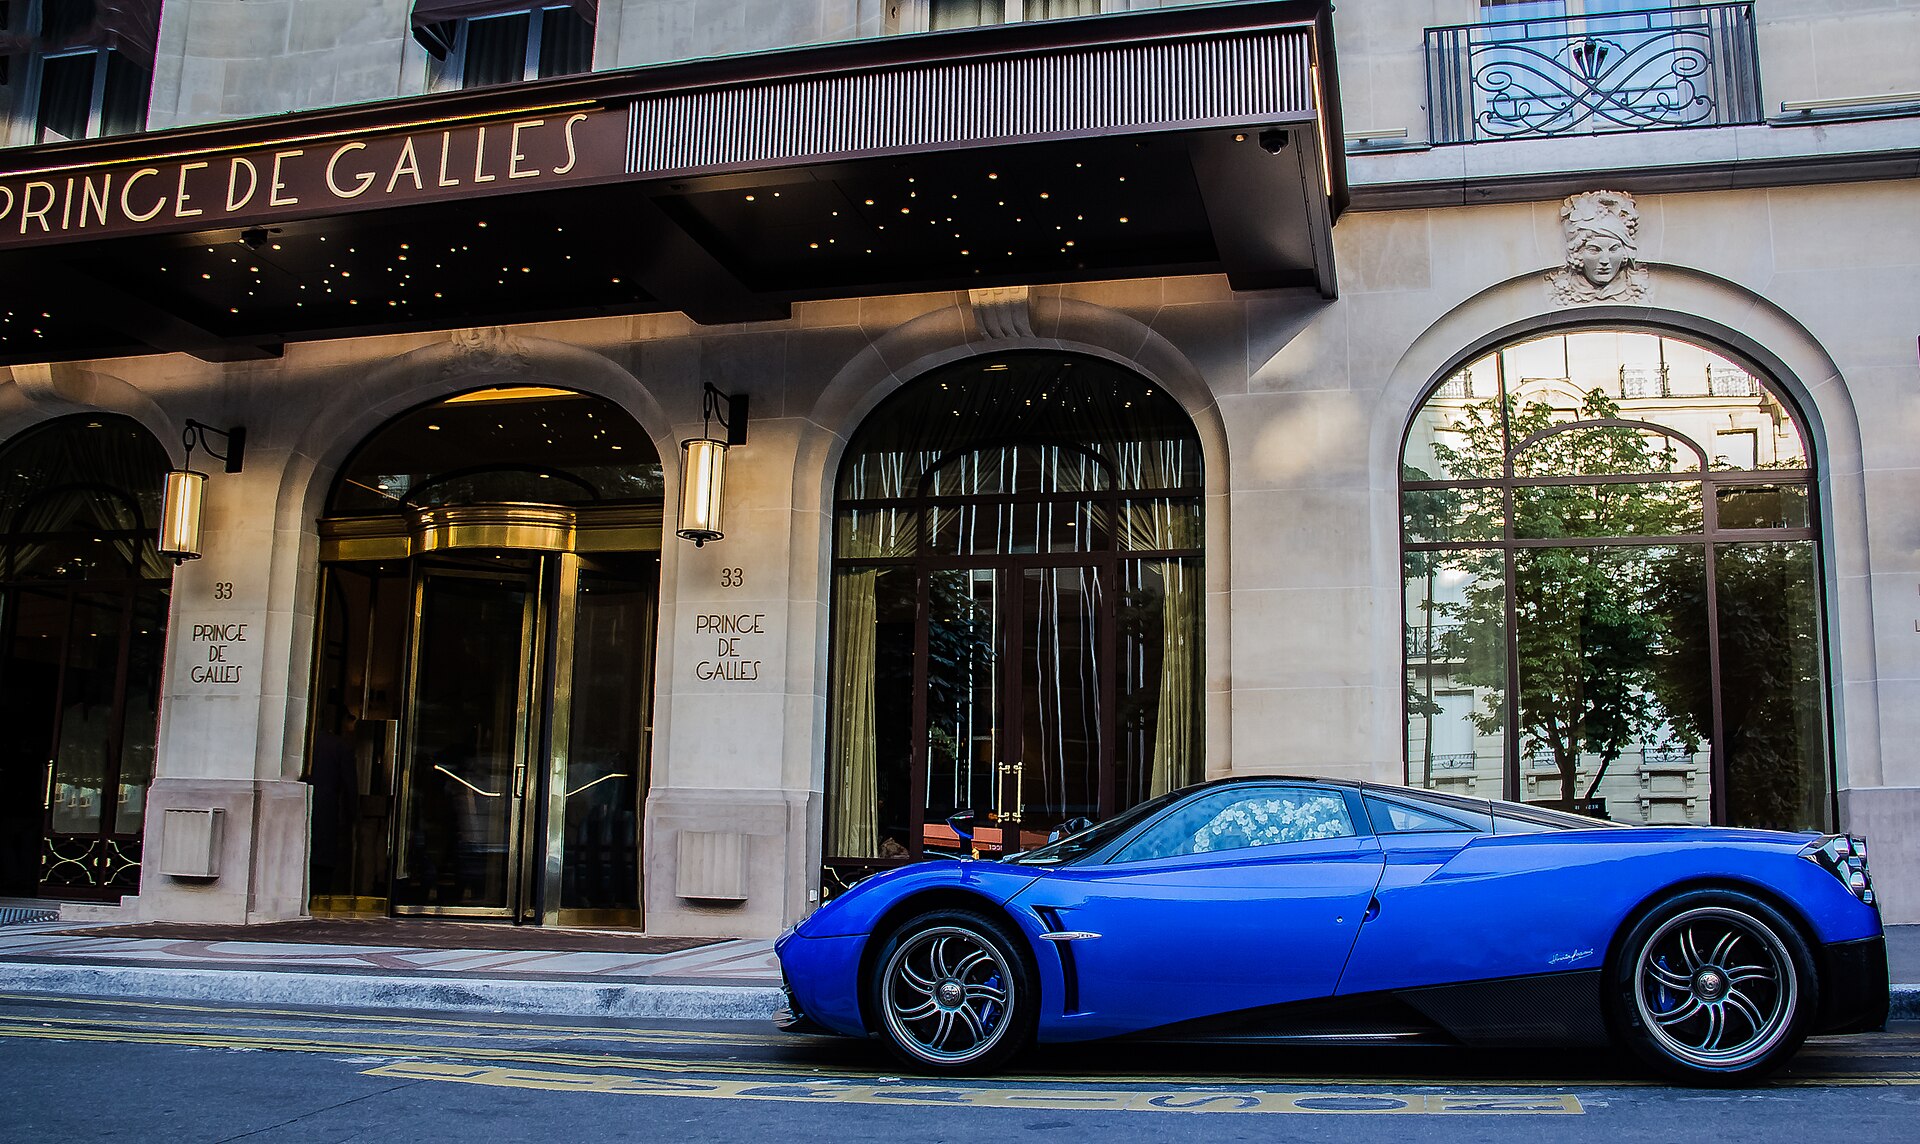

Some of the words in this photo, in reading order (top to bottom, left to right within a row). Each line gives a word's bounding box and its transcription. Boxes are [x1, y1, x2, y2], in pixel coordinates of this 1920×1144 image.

[226, 150, 304, 212] DE
[325, 114, 588, 199] GALLES
[720, 567, 744, 587] 33
[214, 582, 233, 600] 33
[192, 624, 248, 642] PRINCE
[695, 614, 765, 634] PRINCE
[208, 645, 228, 662] DE
[718, 638, 741, 657] DE
[191, 665, 243, 683] GALLES
[695, 660, 762, 681] GALLES
